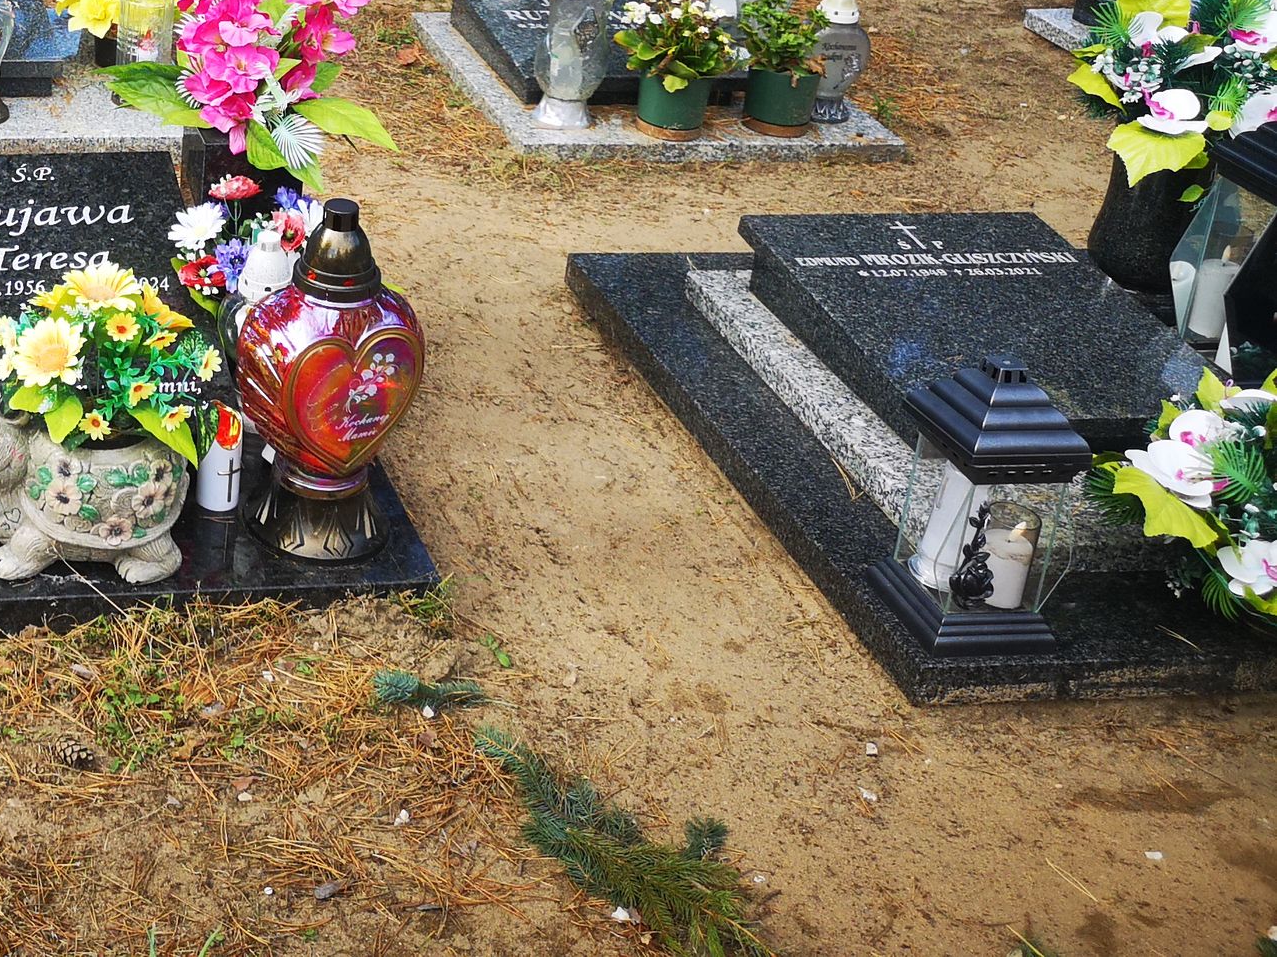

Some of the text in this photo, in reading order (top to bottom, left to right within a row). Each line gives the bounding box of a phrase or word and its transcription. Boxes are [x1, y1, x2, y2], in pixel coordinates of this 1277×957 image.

[11, 164, 56, 183] Ś.P.
[794, 249, 1079, 266] EDMUND MROZIK-GLISZCZYŃSKI
